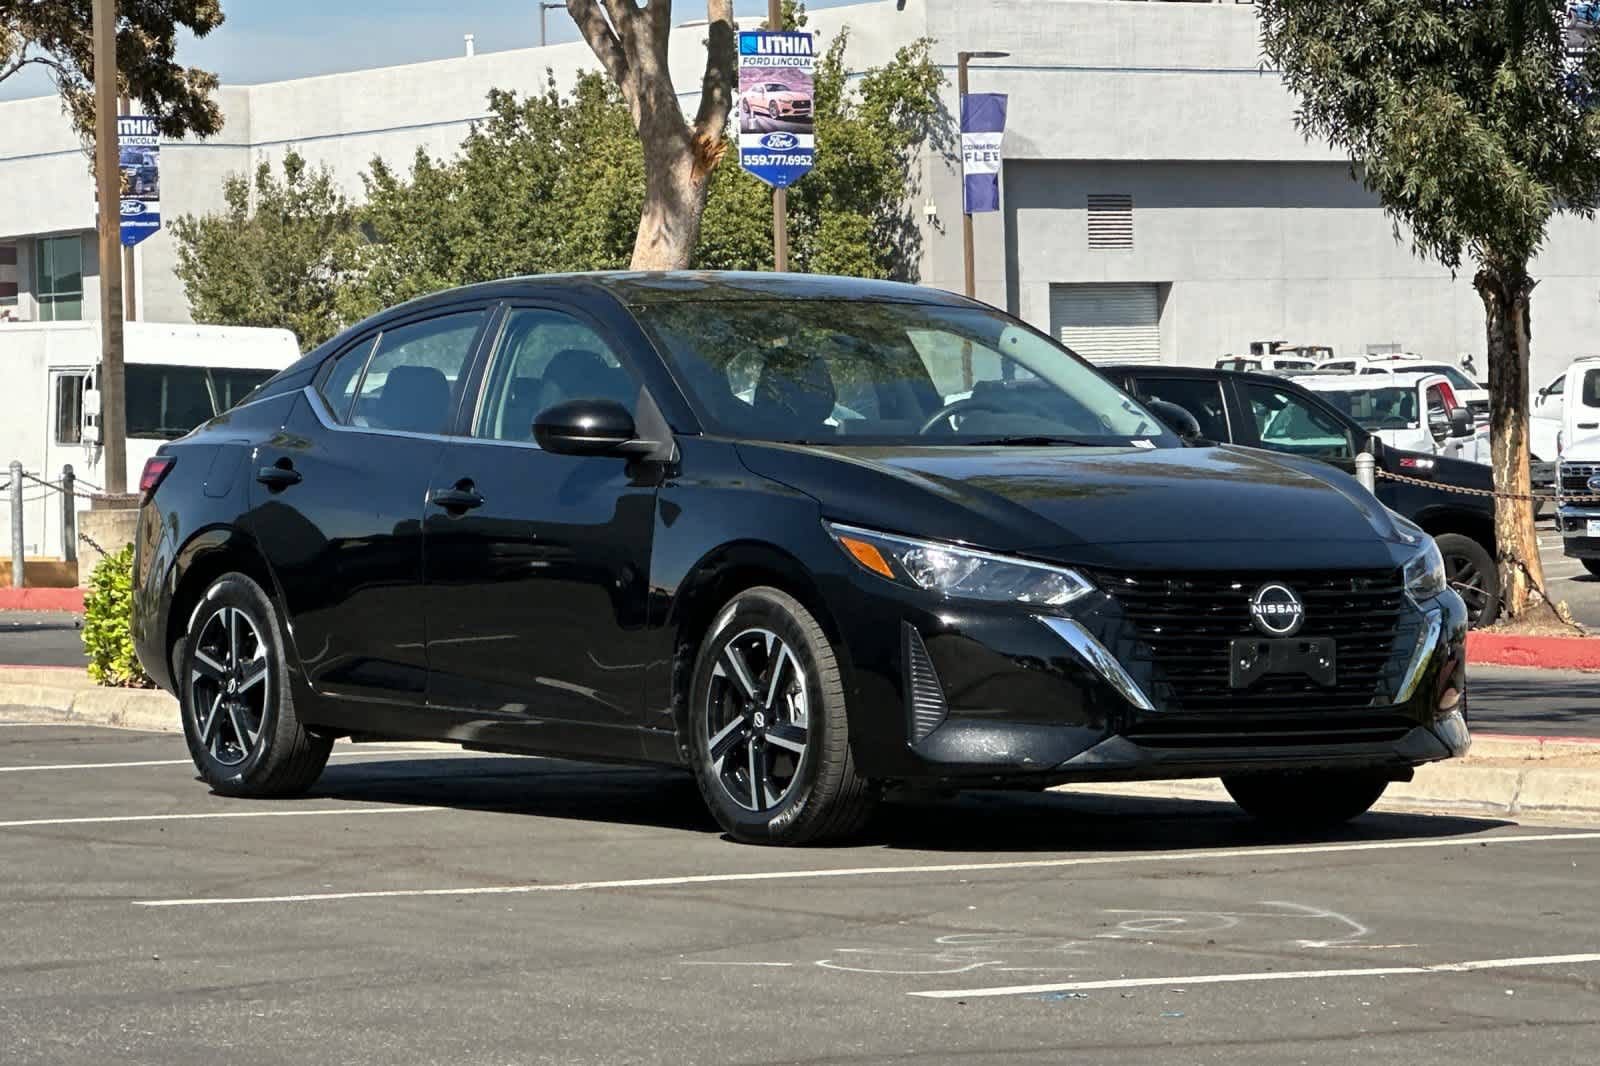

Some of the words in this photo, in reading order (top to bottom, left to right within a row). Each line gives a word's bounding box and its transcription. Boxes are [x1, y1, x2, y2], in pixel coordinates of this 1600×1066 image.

[757, 35, 811, 55] LITHIA
[743, 57, 770, 65] FORD
[772, 57, 810, 66] LINCOLN
[118, 119, 158, 134] ITHIA
[767, 134, 793, 148] Ford
[743, 154, 812, 166] 559.777.6952
[1252, 604, 1301, 614] NISSAN
